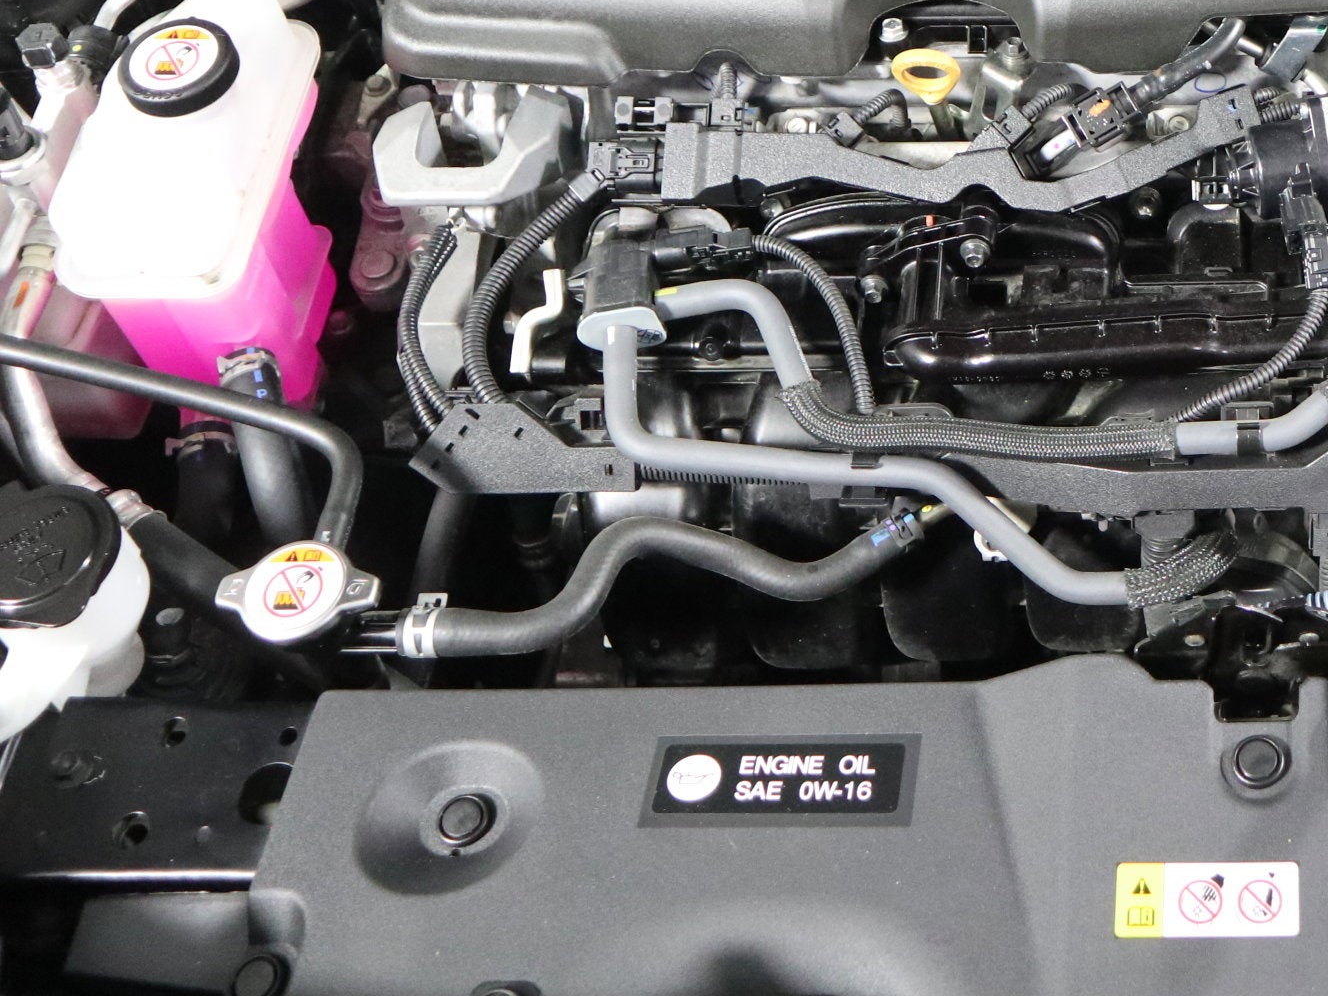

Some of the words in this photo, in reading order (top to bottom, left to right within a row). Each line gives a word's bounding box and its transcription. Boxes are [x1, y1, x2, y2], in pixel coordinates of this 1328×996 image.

[738, 755, 824, 775] ENGINE
[838, 755, 876, 775] OIL
[733, 781, 784, 801] SAE
[798, 780, 873, 801] 0W-16
